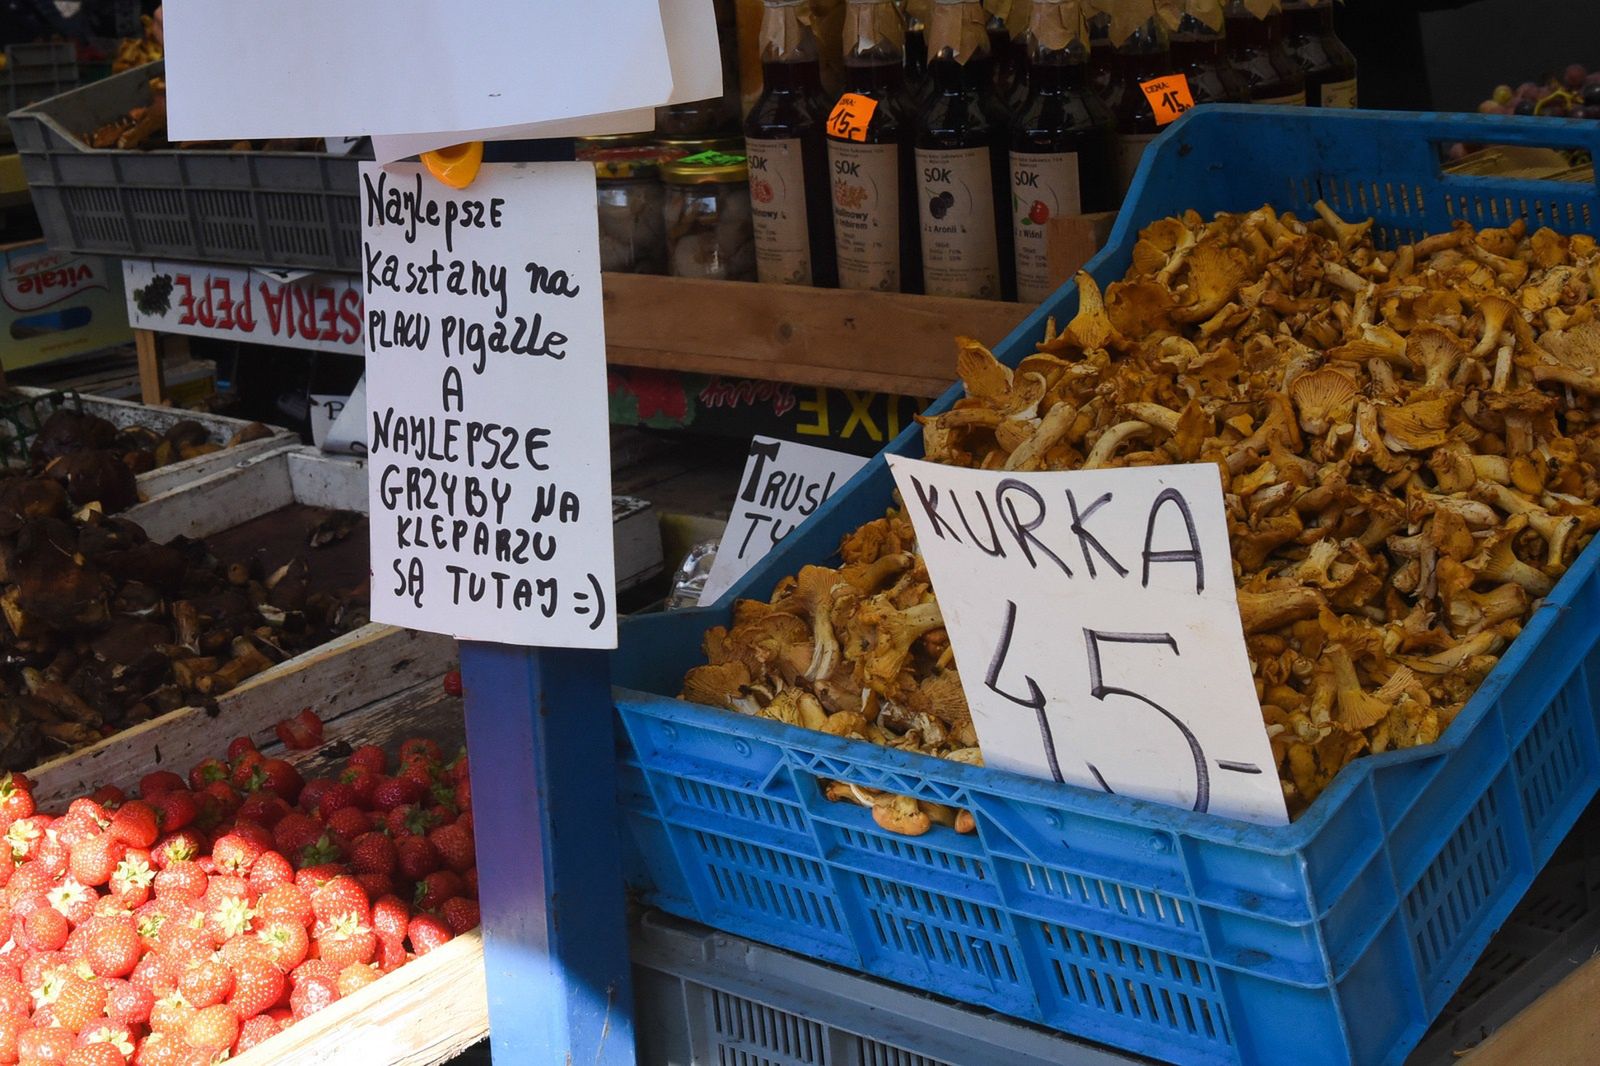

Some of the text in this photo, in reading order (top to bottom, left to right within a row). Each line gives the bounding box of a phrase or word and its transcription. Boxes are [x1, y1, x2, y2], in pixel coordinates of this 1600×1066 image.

[748, 155, 769, 172] SOK
[834, 160, 861, 177] SOK
[923, 168, 952, 184] SOK
[1014, 170, 1040, 188] SOK
[17, 264, 93, 295] vitale
[525, 262, 580, 297] na
[174, 273, 364, 345] SERIA PEPE
[442, 365, 465, 412] A
[371, 407, 551, 471] NAJLEPSZE
[380, 464, 580, 524] GRZYBY NA
[397, 515, 557, 564] KLEPARZU
[910, 474, 1205, 595] KURKA
[393, 557, 424, 608] SĄ
[446, 565, 558, 618] TUTAJ
